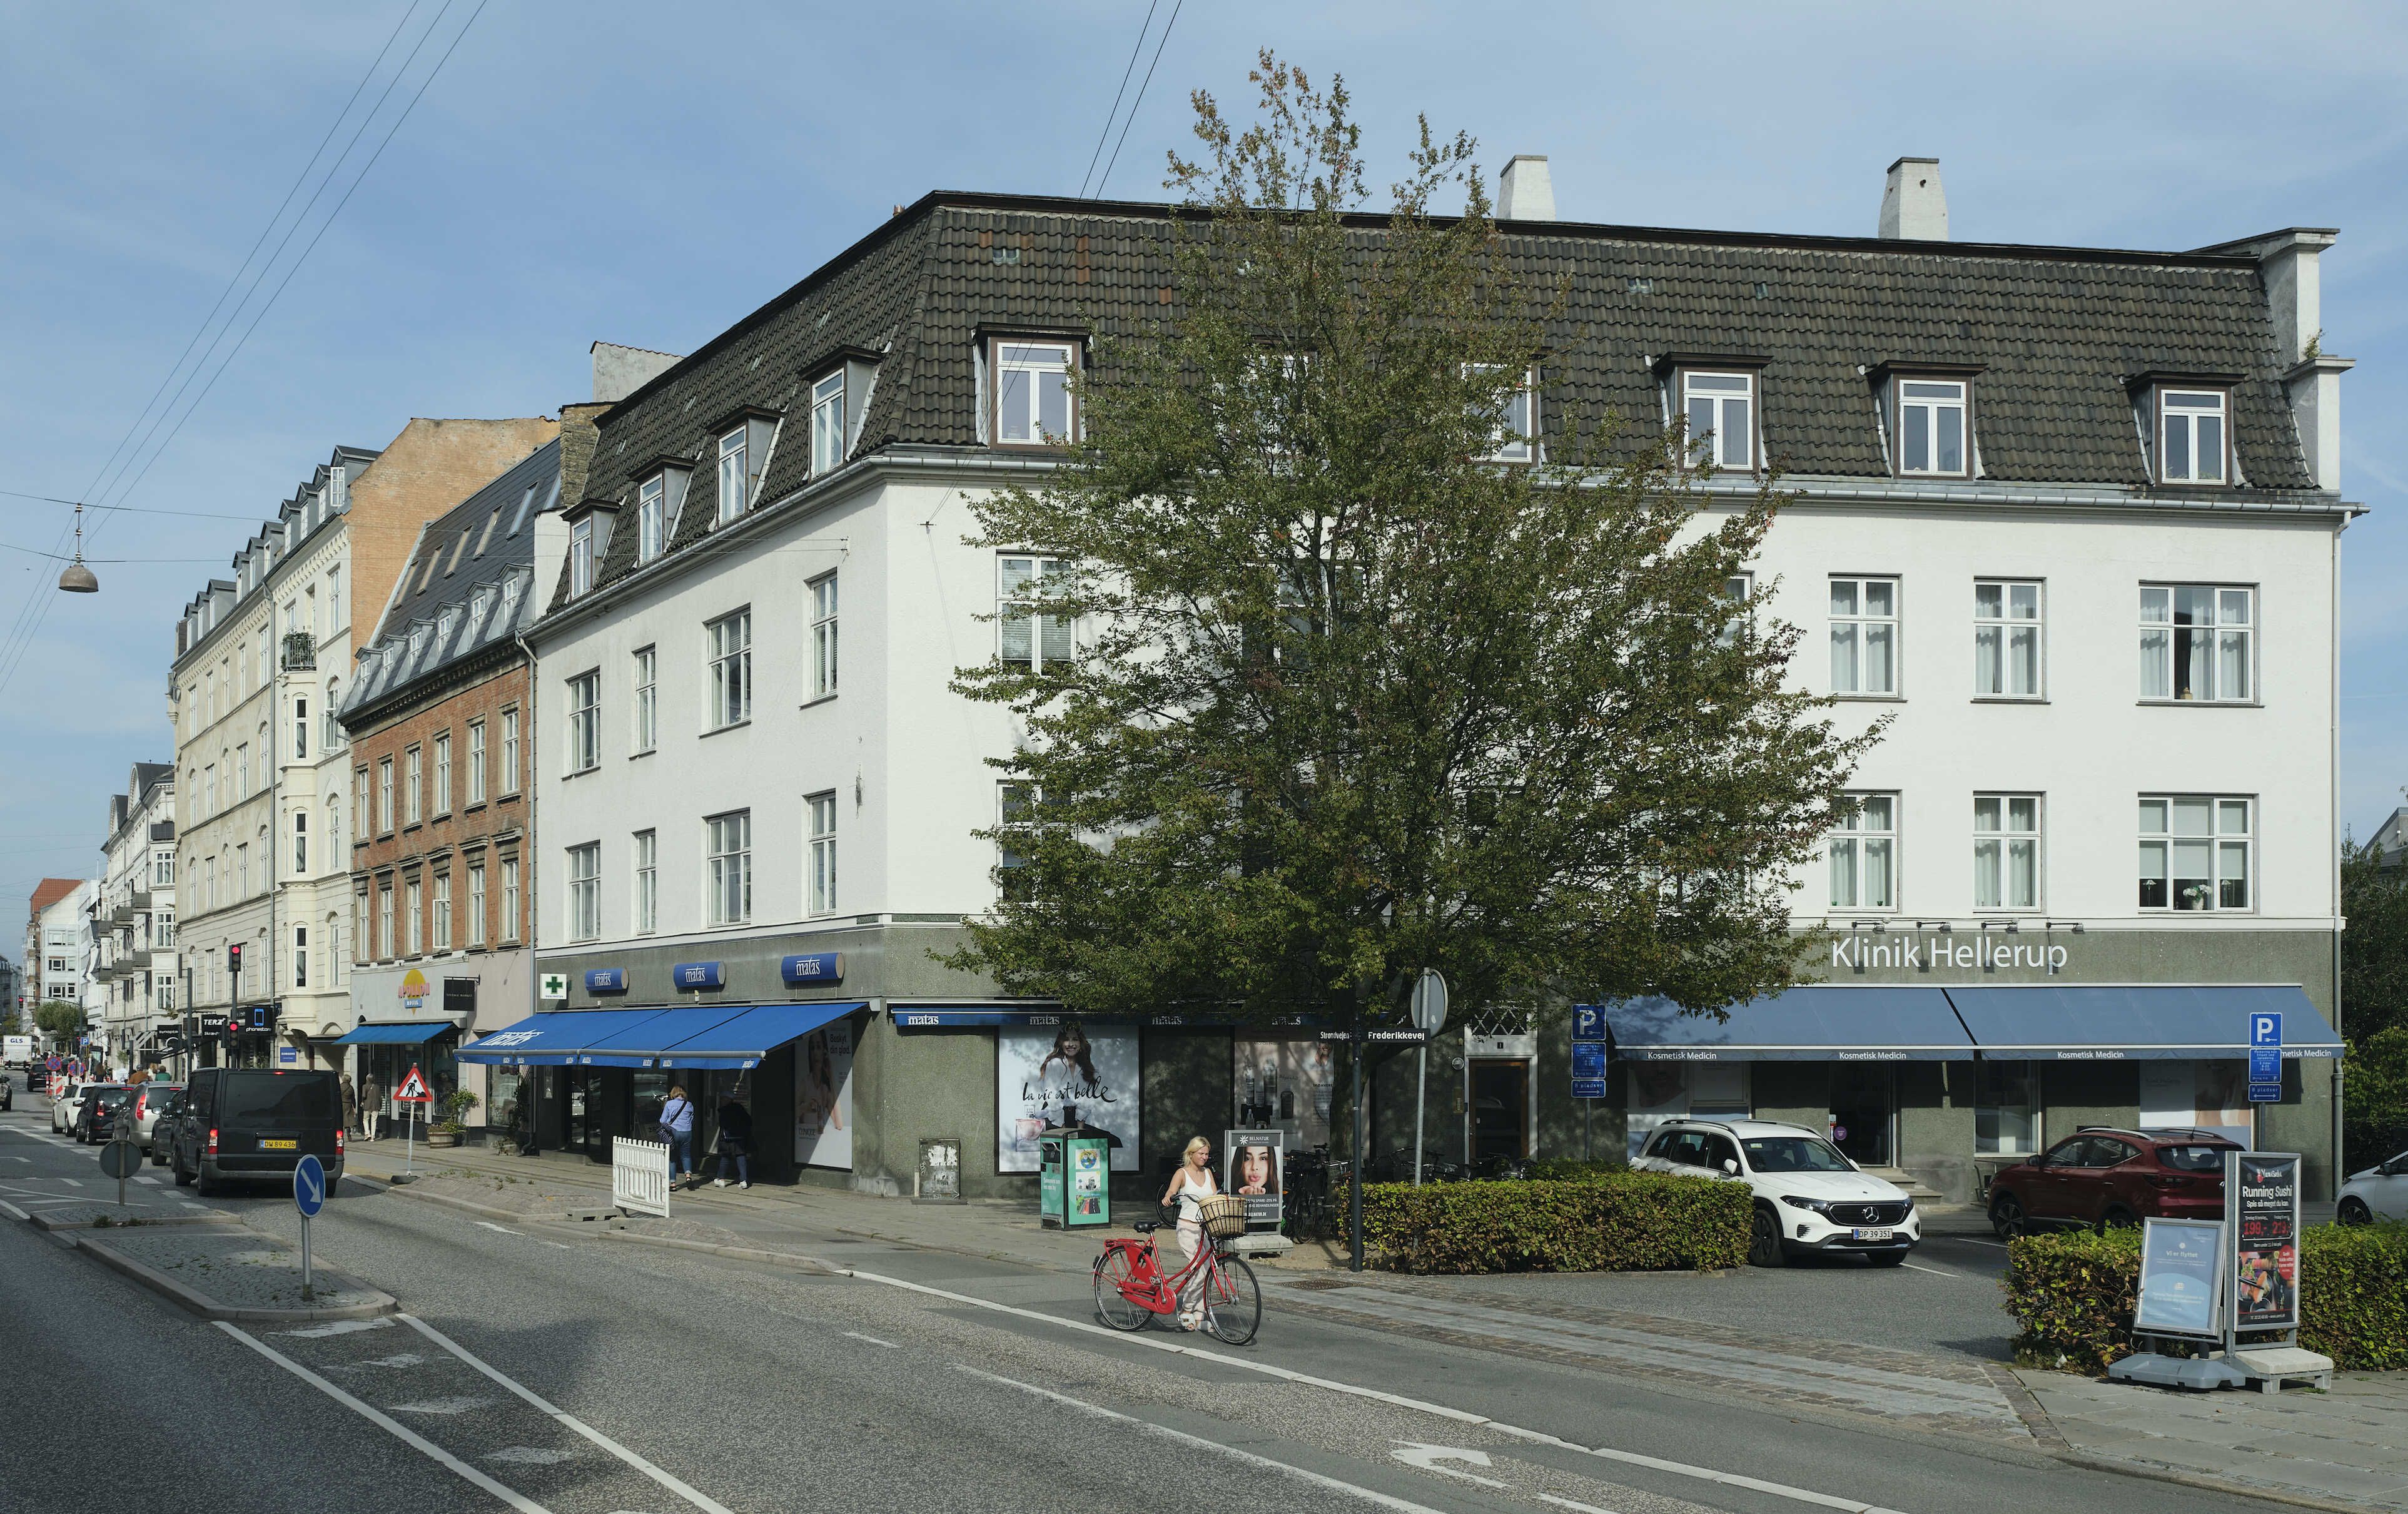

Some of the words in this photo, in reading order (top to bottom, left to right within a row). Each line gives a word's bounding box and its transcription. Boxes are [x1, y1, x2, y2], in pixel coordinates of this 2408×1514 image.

[1832, 937, 1921, 967] Klinik
[1930, 937, 2067, 975] Hellerup
[685, 965, 706, 982] matas
[796, 958, 821, 976] matas
[594, 970, 611, 987] matas
[908, 1014, 939, 1025] matas
[1029, 1014, 1060, 1025] matas
[1579, 1010, 1597, 1035] P
[1320, 1031, 1350, 1040] Strandvejen
[1368, 1031, 1425, 1041] Frederikkevej
[2257, 1018, 2274, 1042] P
[1647, 1052, 1686, 1060] Kosmetisk
[1687, 1052, 1717, 1060] Medicin
[1839, 1052, 1876, 1060] Kosmetisk
[1877, 1052, 1907, 1060] Medicin
[2057, 1051, 2094, 1059] Kosmetisk
[1056, 1082, 1073, 1100] est
[1075, 1075, 1118, 1103] belle
[2242, 1185, 2274, 1199] Running
[2275, 1185, 2292, 1197] Sushi
